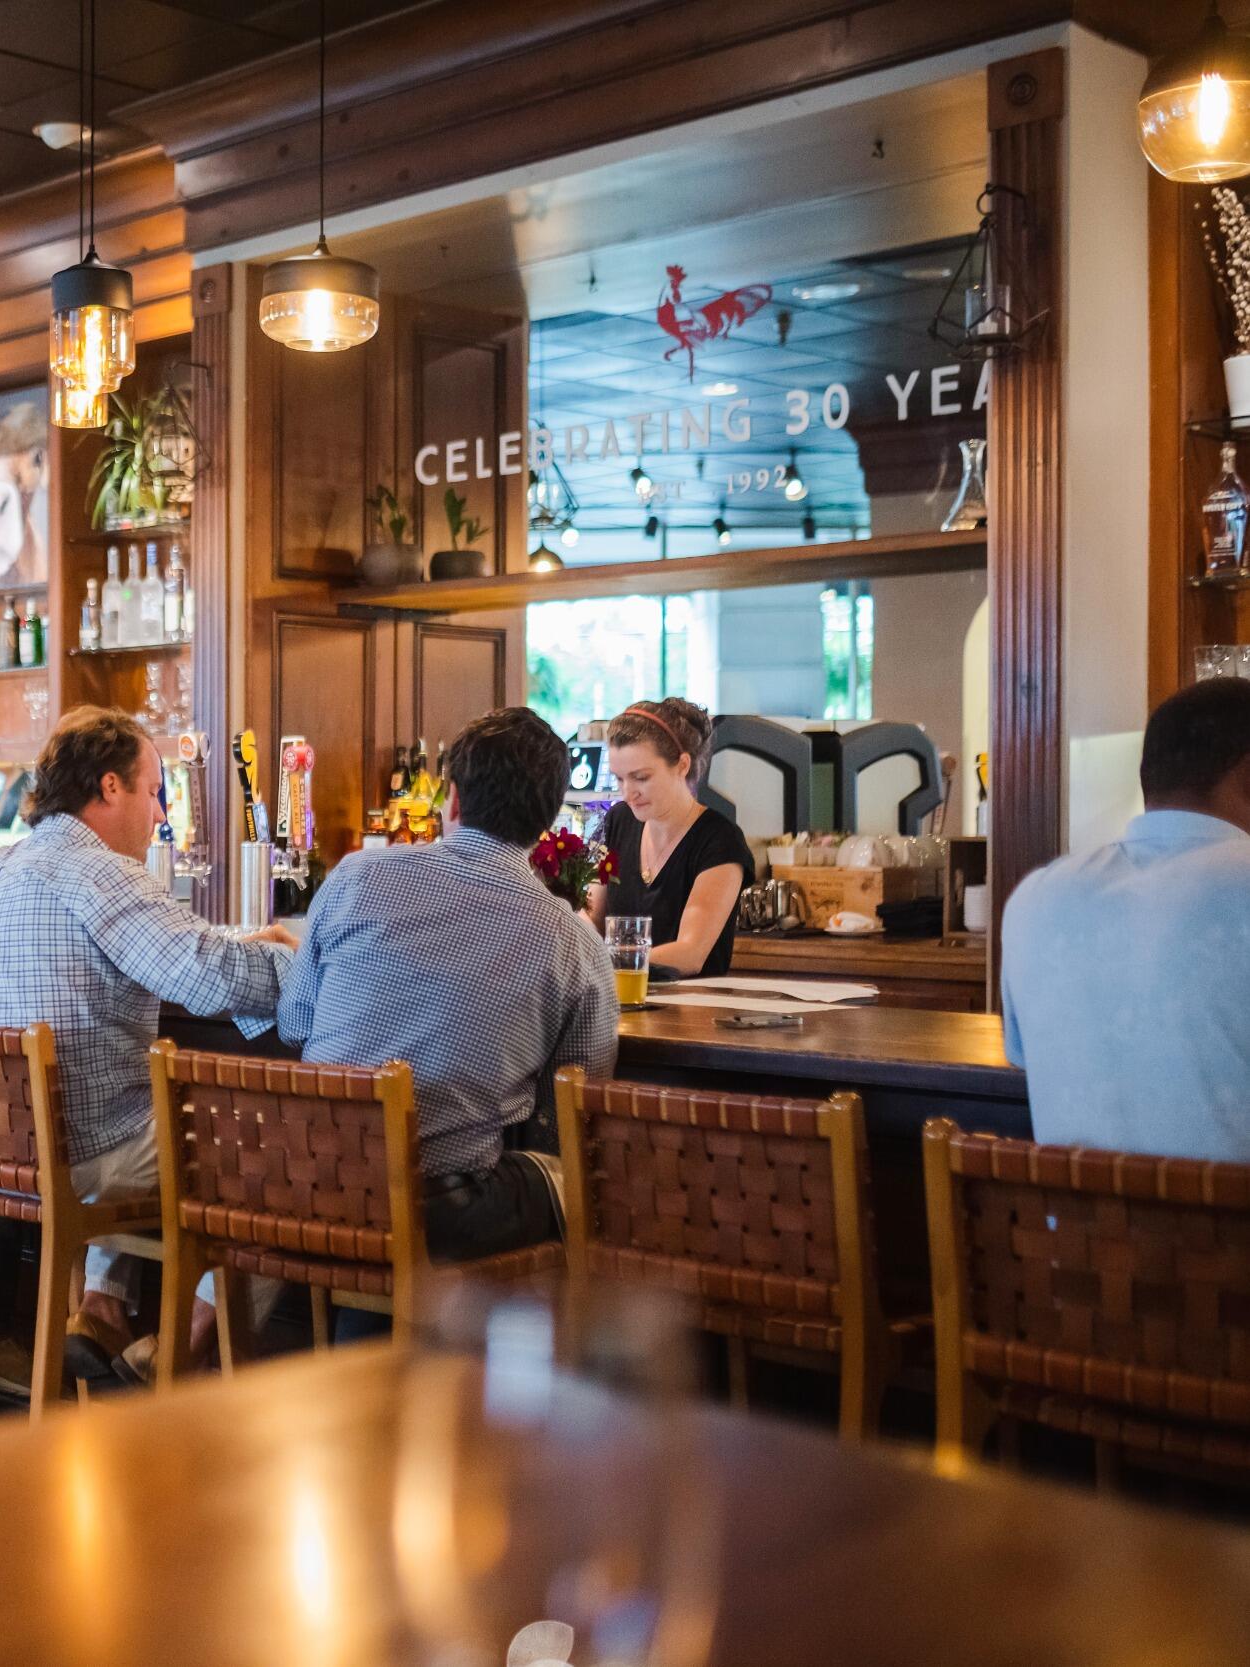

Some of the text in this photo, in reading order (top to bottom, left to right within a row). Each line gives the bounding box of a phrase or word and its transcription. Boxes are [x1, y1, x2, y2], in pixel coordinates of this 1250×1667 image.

[414, 398, 752, 486] CELEBRATING
[785, 382, 850, 436] 30
[726, 463, 788, 495] 1992
